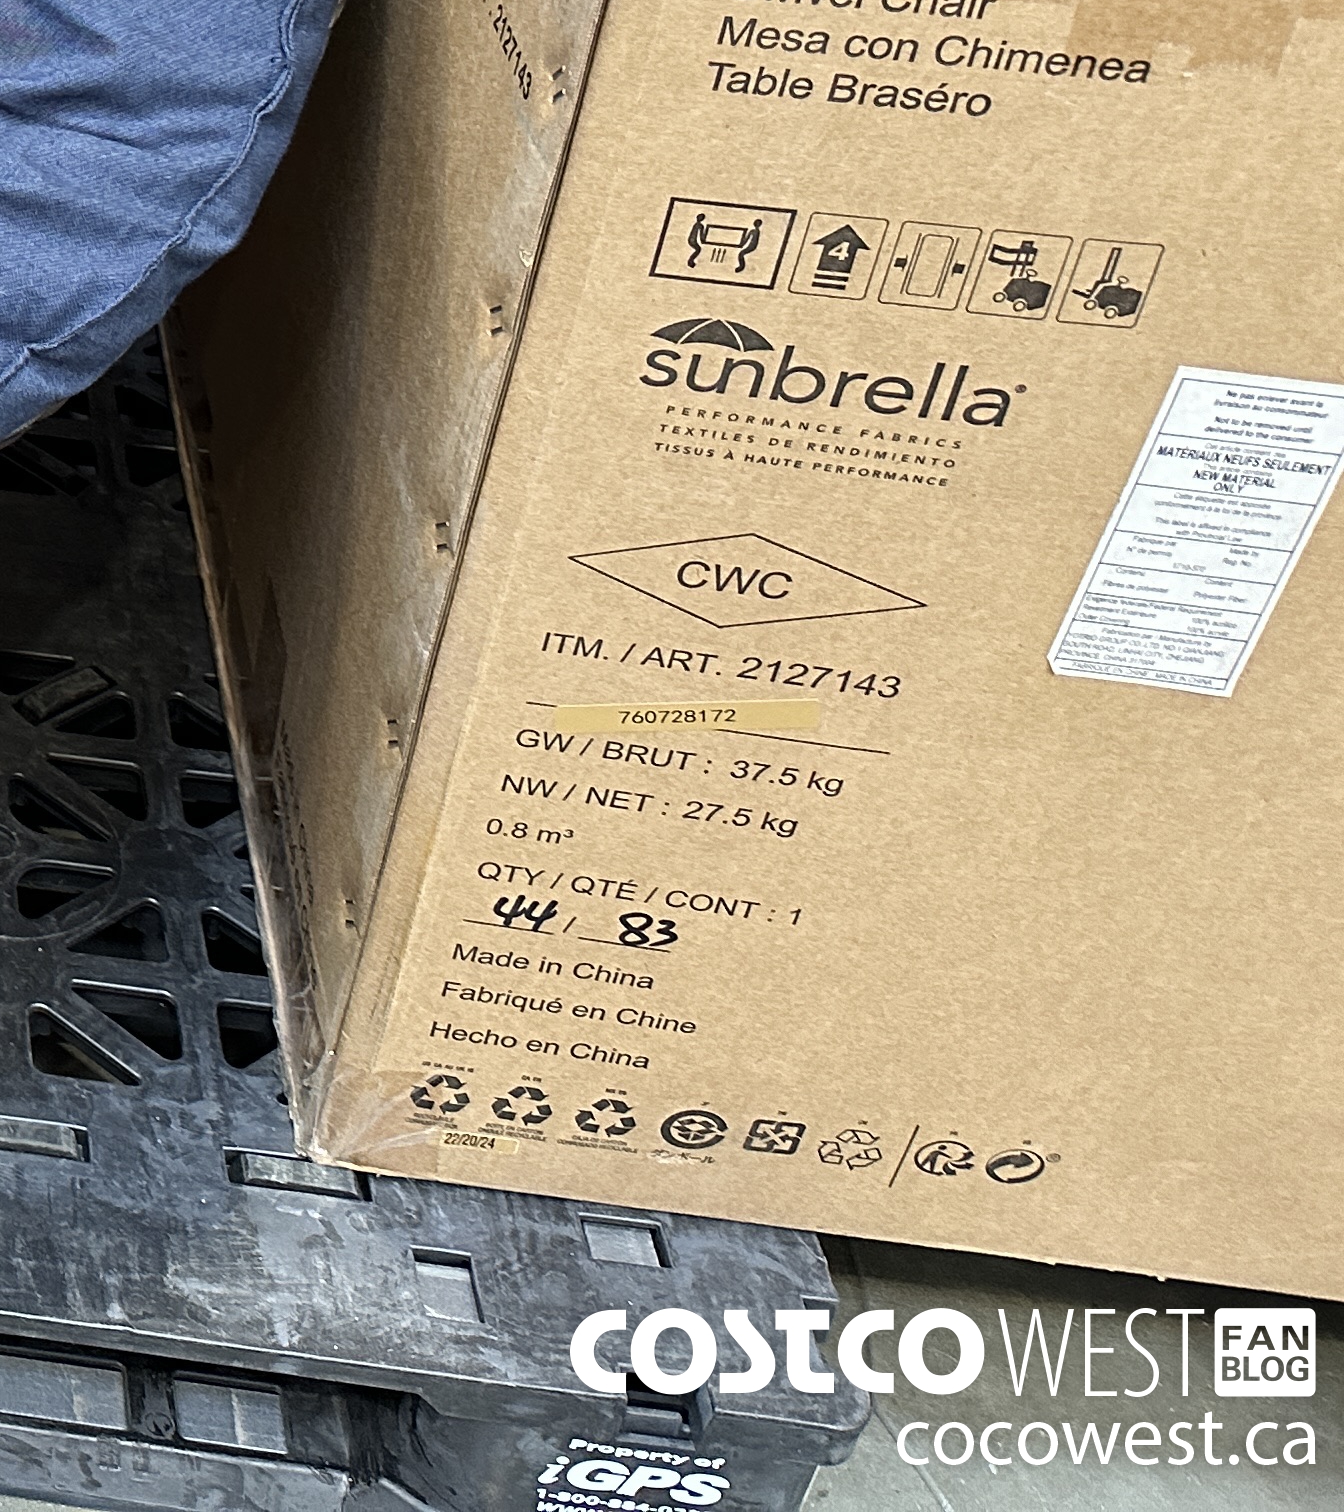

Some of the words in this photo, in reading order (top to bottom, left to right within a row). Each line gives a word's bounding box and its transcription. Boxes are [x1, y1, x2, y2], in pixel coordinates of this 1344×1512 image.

[492, 3, 533, 101] 2127143
[716, 15, 831, 55] Mesa
[844, 34, 919, 63] con
[934, 35, 1152, 85] Chimenea
[708, 61, 814, 100] Table
[826, 73, 992, 117] Braséro
[659, 424, 755, 444] TEXTILES
[767, 437, 794, 449] DE
[807, 442, 956, 469] RENDIMIENTO
[666, 405, 843, 435] PERFORMANCE
[859, 428, 962, 450] FABRICS
[654, 441, 715, 458] TISSUS
[722, 448, 734, 461] À
[743, 453, 804, 469] HAUTE
[812, 461, 949, 487] PERFORMANCE
[676, 560, 793, 600] CWC
[736, 656, 901, 699] 2127143
[618, 708, 736, 724] 760728172
[515, 728, 575, 753] GW
[602, 740, 698, 771] BRUT
[729, 760, 800, 786] 37.5
[806, 770, 844, 798] kg
[486, 818, 529, 839] 0.8
[500, 774, 559, 799] NW
[584, 786, 655, 812] NET
[681, 800, 754, 827] 27.5
[760, 811, 799, 838] kg
[477, 861, 546, 886] QTY
[570, 875, 639, 902] QTÉ
[665, 890, 762, 919] CONT
[790, 908, 802, 926] 1
[492, 895, 557, 933] 44
[618, 912, 680, 949] 83
[451, 943, 530, 970] Made
[538, 956, 563, 976] in
[572, 962, 654, 990] China
[441, 980, 563, 1014] Fabriqué
[571, 1004, 606, 1021] en
[616, 1007, 697, 1034] Chine
[429, 1020, 518, 1049] Hecho
[525, 1039, 560, 1056] en
[569, 1042, 650, 1070] China
[443, 1132, 496, 1150] 22/20/24
[569, 1438, 690, 1465] Property
[694, 1458, 726, 1469] of
[537, 1456, 731, 1505] iGPS
